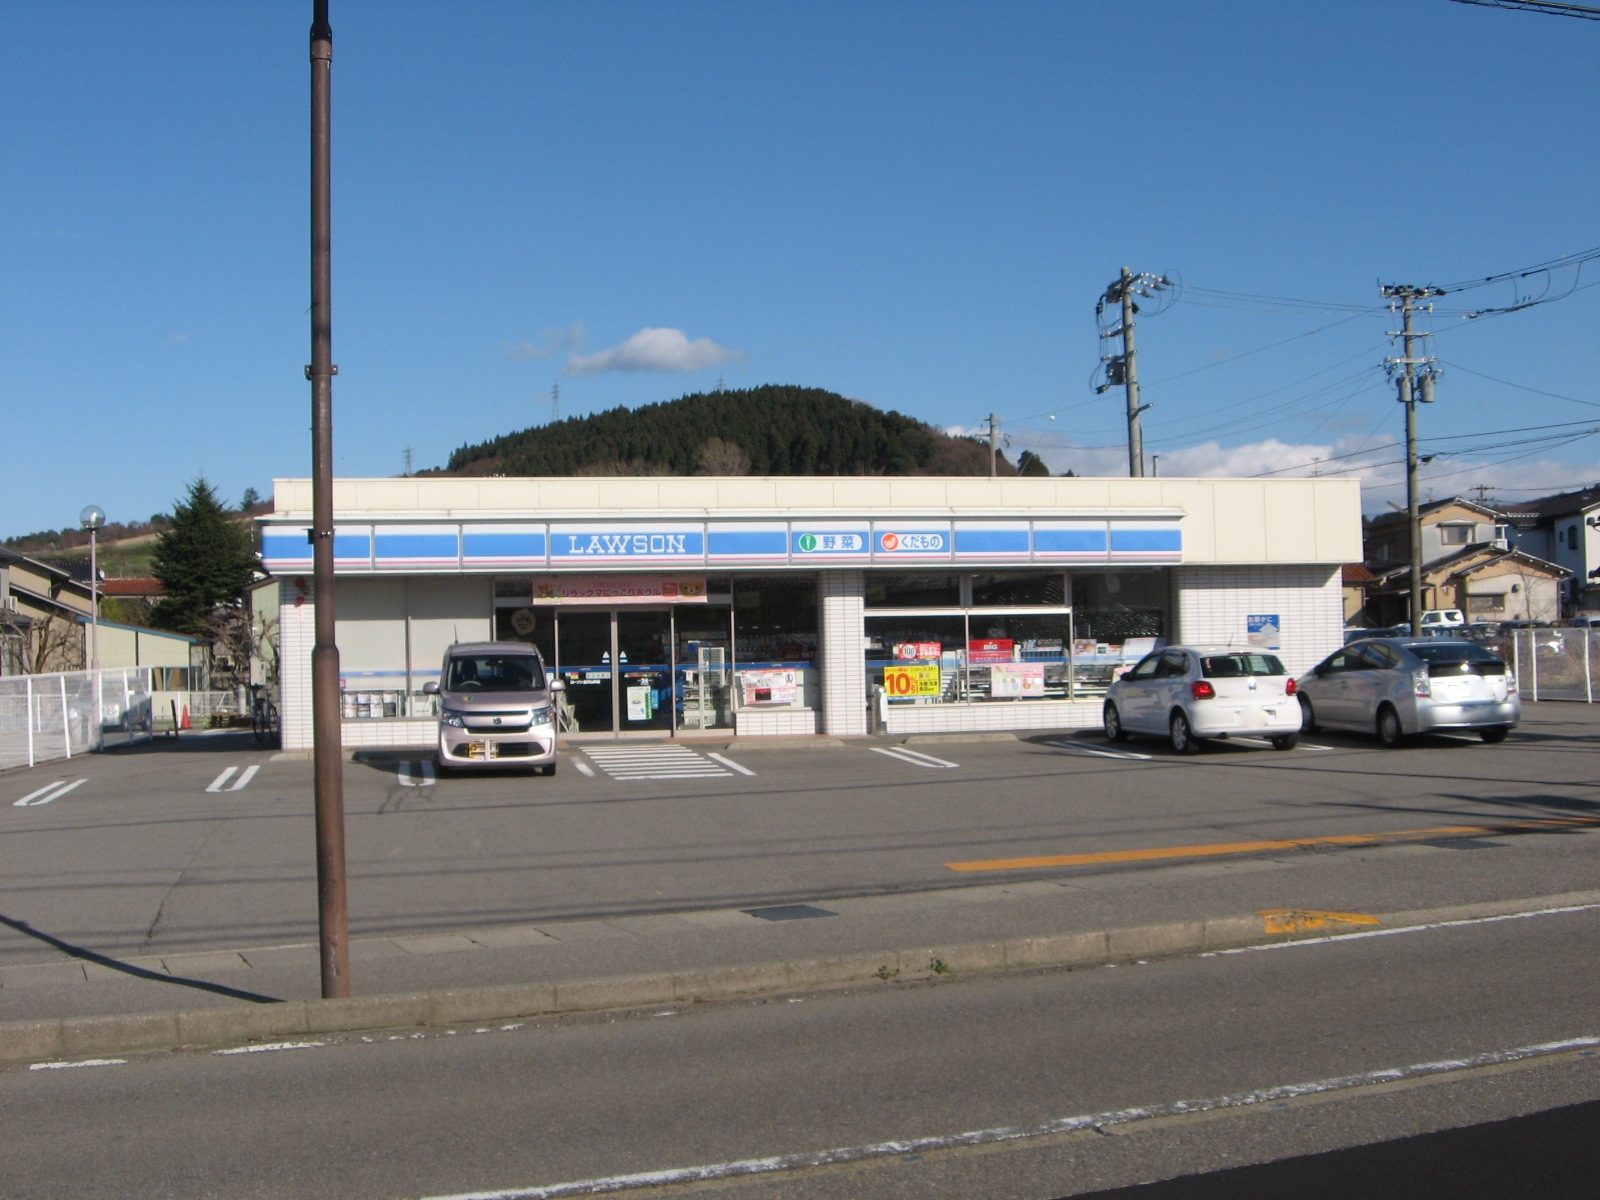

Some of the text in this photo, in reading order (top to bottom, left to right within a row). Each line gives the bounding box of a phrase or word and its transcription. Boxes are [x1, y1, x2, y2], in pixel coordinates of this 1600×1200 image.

[568, 534, 686, 555] LAWSON
[822, 536, 855, 550] 野菜
[900, 536, 940, 550] くだもの
